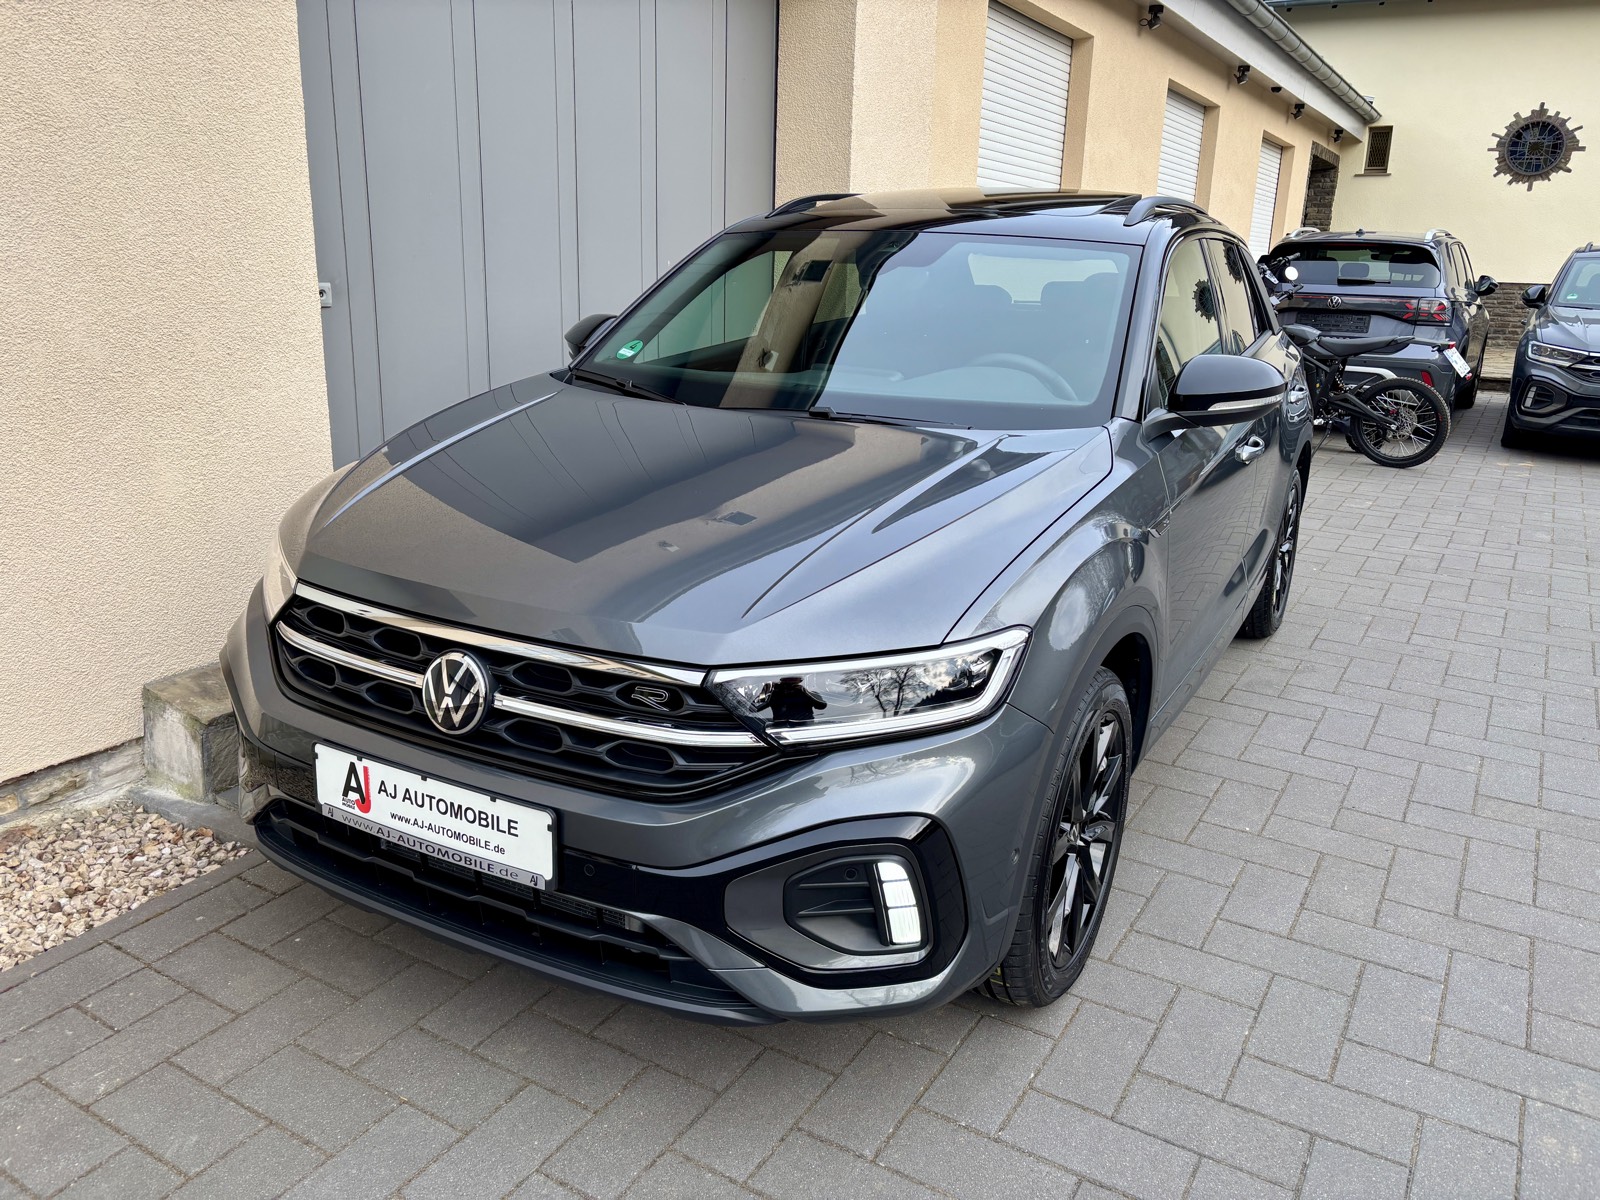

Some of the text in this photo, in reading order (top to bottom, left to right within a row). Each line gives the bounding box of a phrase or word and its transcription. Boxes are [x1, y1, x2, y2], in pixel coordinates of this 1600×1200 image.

[629, 341, 641, 350] 4
[342, 761, 371, 814] AJ
[377, 780, 397, 800] AJ
[402, 787, 519, 838] AUTOMOBILE
[341, 814, 519, 880] www.AJ-AUTOMOBILE.de
[390, 811, 506, 855] www.AJ-AUTOMOBILE.de
